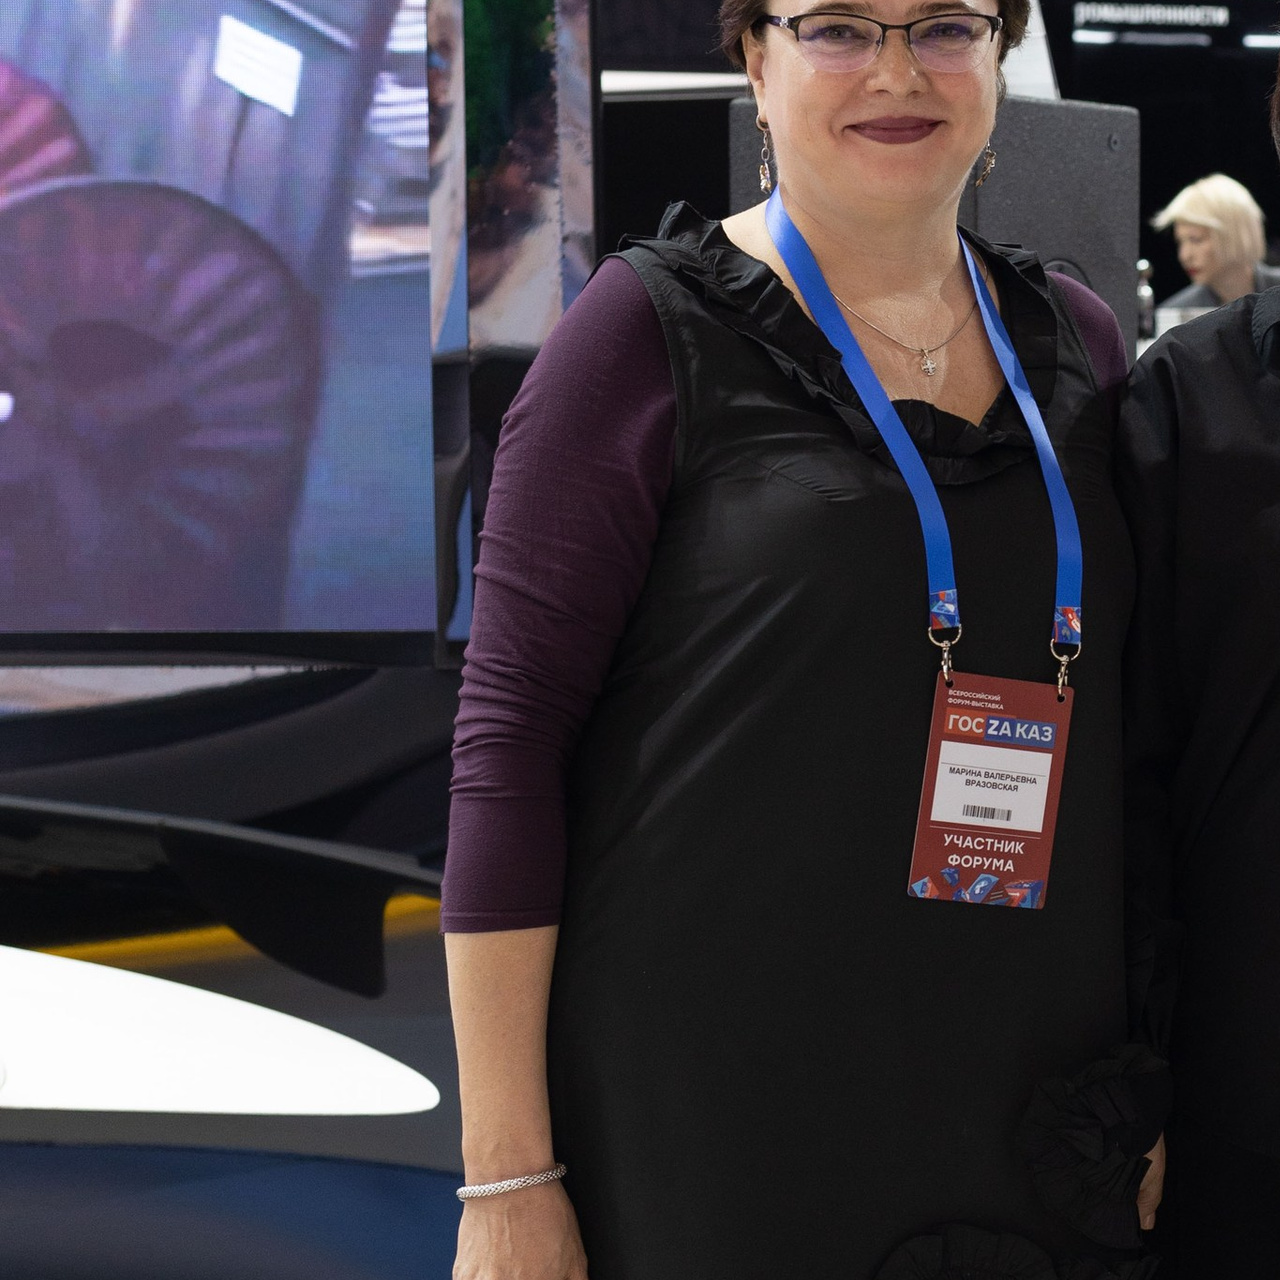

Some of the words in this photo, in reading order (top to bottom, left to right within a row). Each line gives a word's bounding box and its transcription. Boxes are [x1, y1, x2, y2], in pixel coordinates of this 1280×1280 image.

[948, 689, 1001, 700] ВСЕРОССИЙСКИЙ
[947, 698, 1004, 710] ФОРУМ-ВЫСТАВКА
[949, 767, 982, 778] МАРИНА
[984, 771, 1037, 784] ВАЛЕРЬЕВНА
[965, 779, 1019, 792] ВРАЗОВСКАЯ
[943, 833, 1025, 855] УЧАСТНИК
[947, 853, 1015, 872] ФОРУМА
